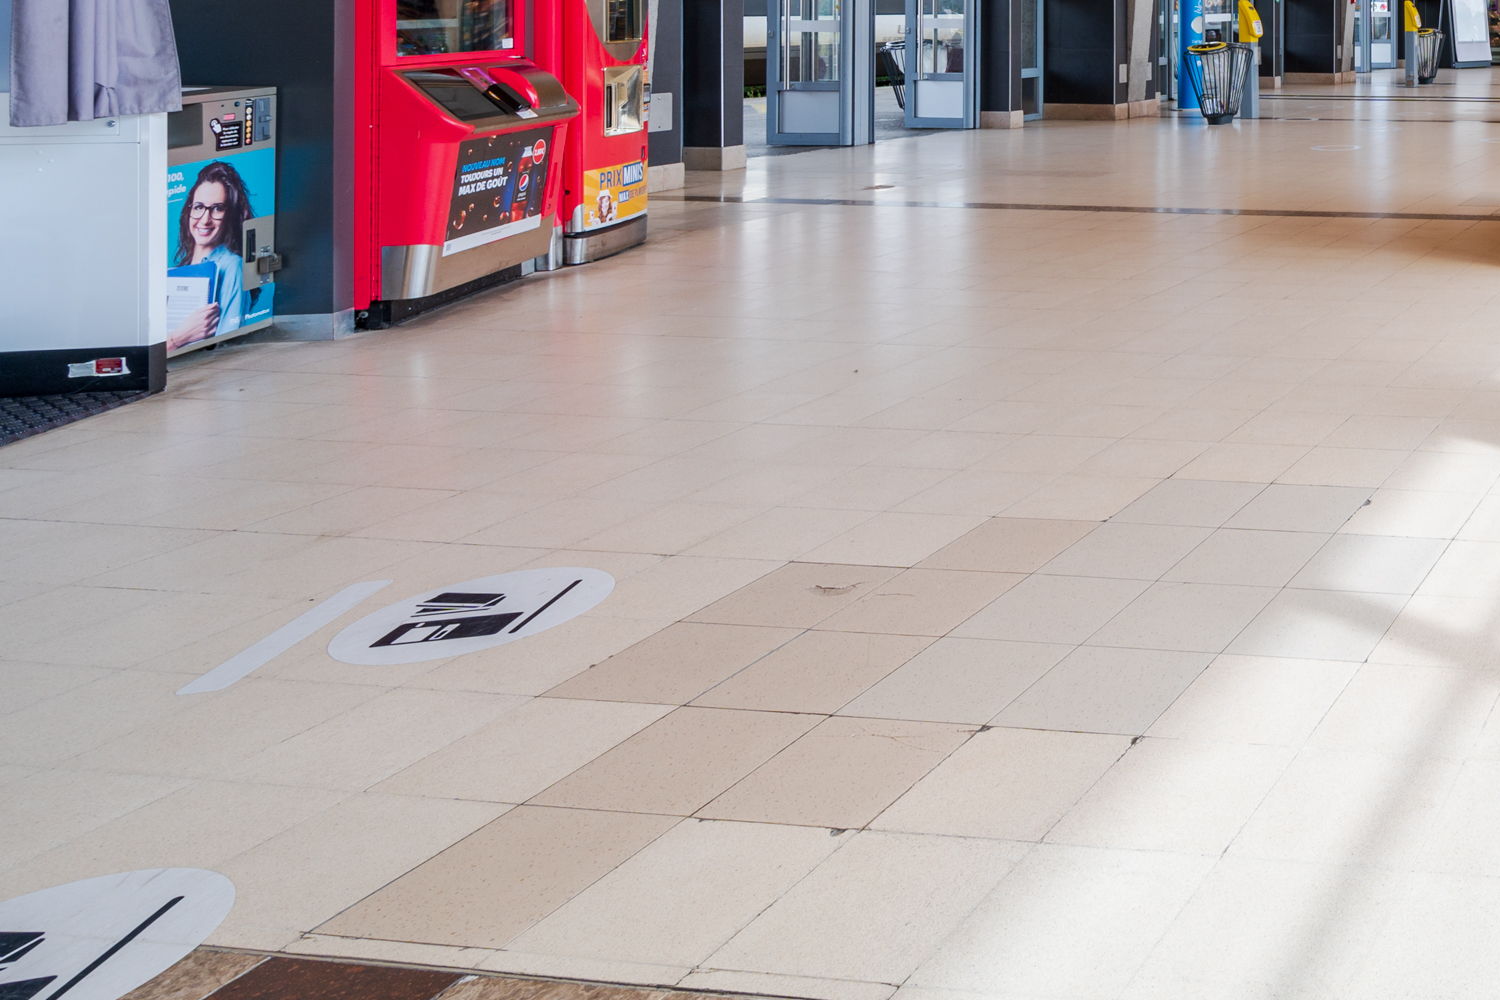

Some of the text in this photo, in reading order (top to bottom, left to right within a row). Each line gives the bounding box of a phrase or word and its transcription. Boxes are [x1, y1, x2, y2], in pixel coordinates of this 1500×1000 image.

[462, 157, 506, 173] NOUVEAU NOM
[460, 167, 504, 184] TOUJOURS UN
[600, 161, 643, 189] PRIX MINIS
[167, 185, 187, 198] pide
[458, 176, 508, 196] MAX DE GOÛT
[619, 190, 629, 203] MAX
[244, 308, 270, 320] Photomaton
